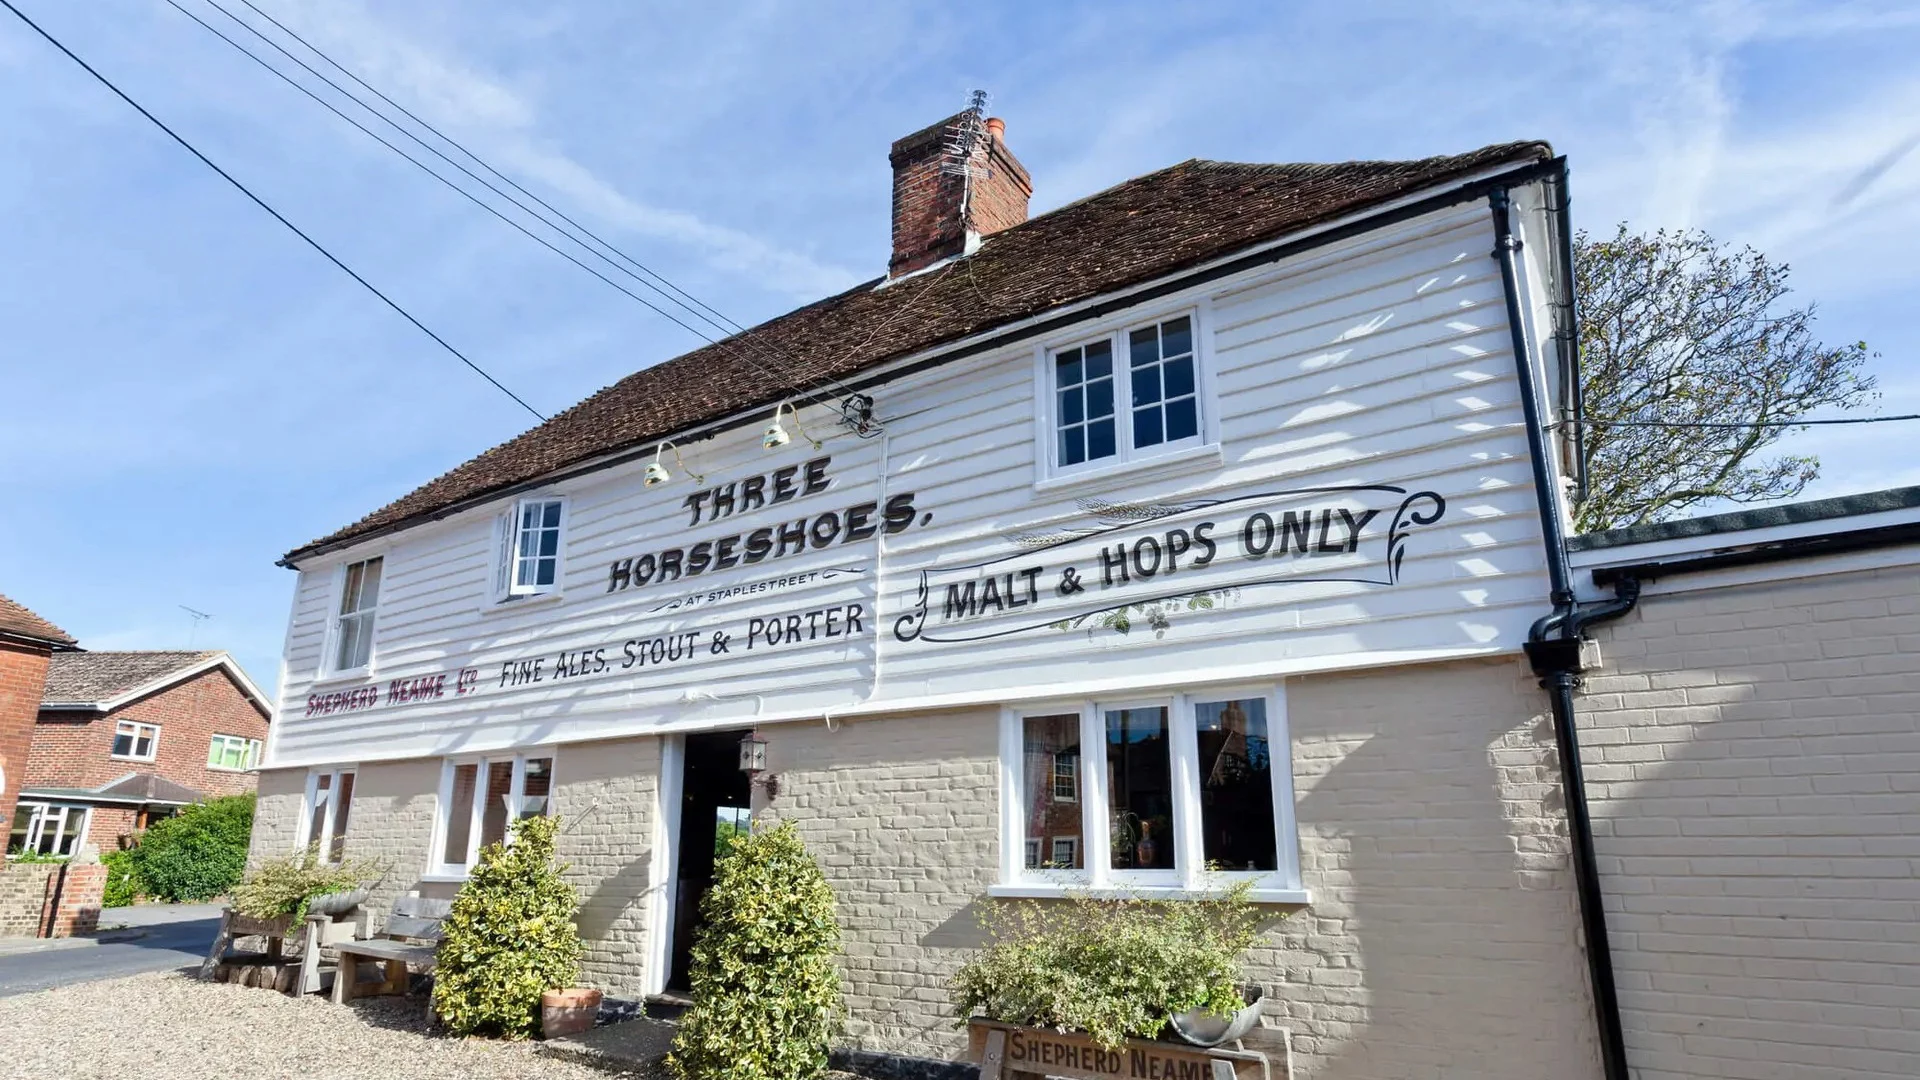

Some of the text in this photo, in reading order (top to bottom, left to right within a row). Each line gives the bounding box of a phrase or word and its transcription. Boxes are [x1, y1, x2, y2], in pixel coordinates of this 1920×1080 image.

[683, 457, 831, 526] THREE
[607, 493, 933, 592] HORSESHOES.
[945, 508, 1380, 619] MALT & HOPS ONLY
[686, 573, 817, 606] AT STAPLESTREET
[500, 658, 545, 688] FINE
[621, 631, 700, 668] STOUT
[710, 630, 732, 655] &
[746, 603, 864, 650] PORTER
[306, 687, 378, 716] SHEPHERD
[388, 674, 446, 705] NEAME
[1011, 1033, 1121, 1075] SHEPHERD
